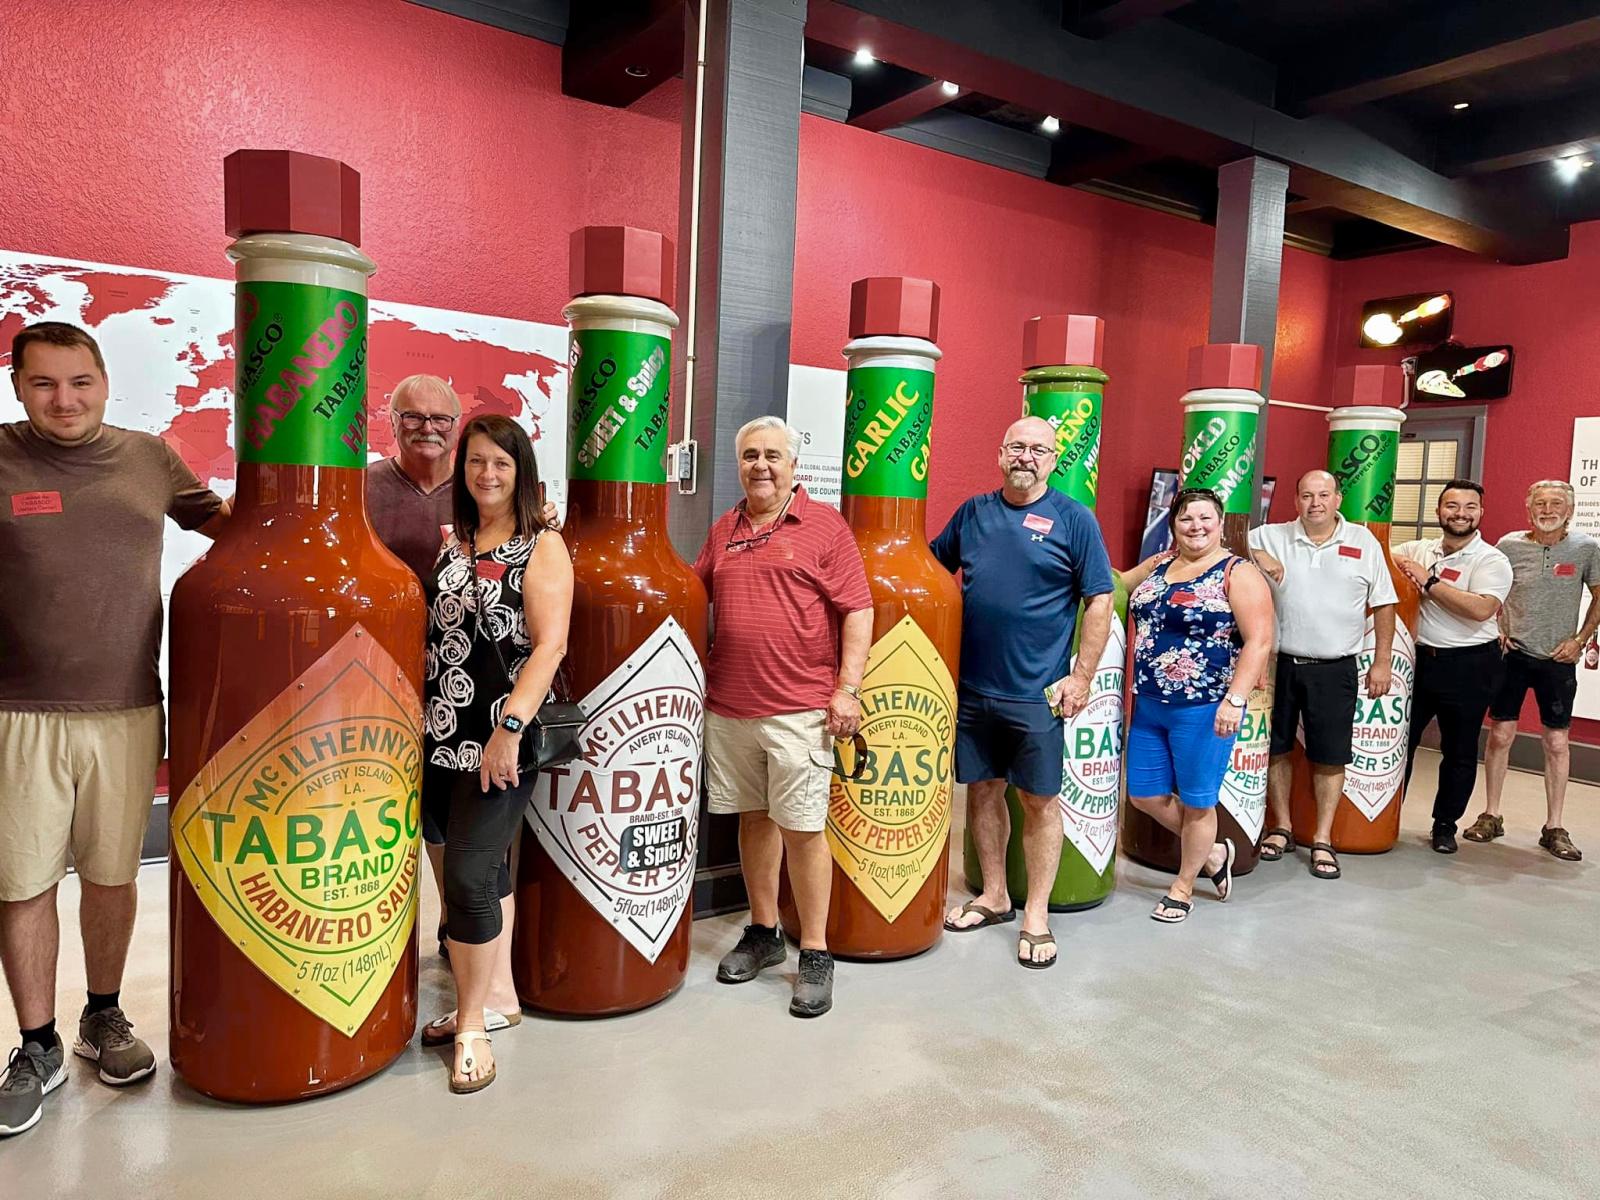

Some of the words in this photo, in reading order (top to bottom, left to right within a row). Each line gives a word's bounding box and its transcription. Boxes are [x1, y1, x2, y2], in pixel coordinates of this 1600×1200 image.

[245, 300, 358, 450] HABANERO
[313, 336, 367, 419] TABASCO
[578, 405, 627, 468] SWEET
[619, 395, 639, 413] &
[846, 381, 919, 478] GARLIC
[886, 402, 930, 465] TABASCO
[1053, 415, 1098, 478] TABASCO
[1194, 435, 1240, 485] TABASCO
[1580, 475, 1597, 487] OF
[1087, 699, 1107, 716] AVERY
[628, 731, 662, 755] AVERY
[665, 729, 691, 747] ISLAND
[867, 720, 897, 736] AVERY
[900, 720, 928, 738] ISLAND
[1353, 727, 1397, 739] BRAND
[657, 744, 672, 755] LA.
[306, 767, 350, 796] AVERY
[354, 765, 394, 786] ISLAND
[1082, 760, 1120, 777] BRAND
[344, 783, 366, 795] LA.
[860, 789, 926, 806] BRAND
[1081, 790, 1117, 814] PEPPER
[829, 783, 867, 838] GARLIC
[865, 823, 923, 850] PEPPER
[922, 784, 948, 834] SAUCE
[874, 808, 892, 816] EST.
[895, 808, 915, 816] 1868
[633, 819, 681, 847] SWEET
[627, 851, 640, 868] &
[644, 841, 683, 866] Spicy
[859, 857, 869, 871] 5
[301, 852, 394, 890] BRAND
[240, 872, 372, 945] HABANERO
[380, 845, 417, 923] SAUCE
[323, 887, 349, 901] EST.
[354, 880, 380, 896] 1868
[297, 961, 310, 980] 5
[343, 941, 391, 984] (148mL)
